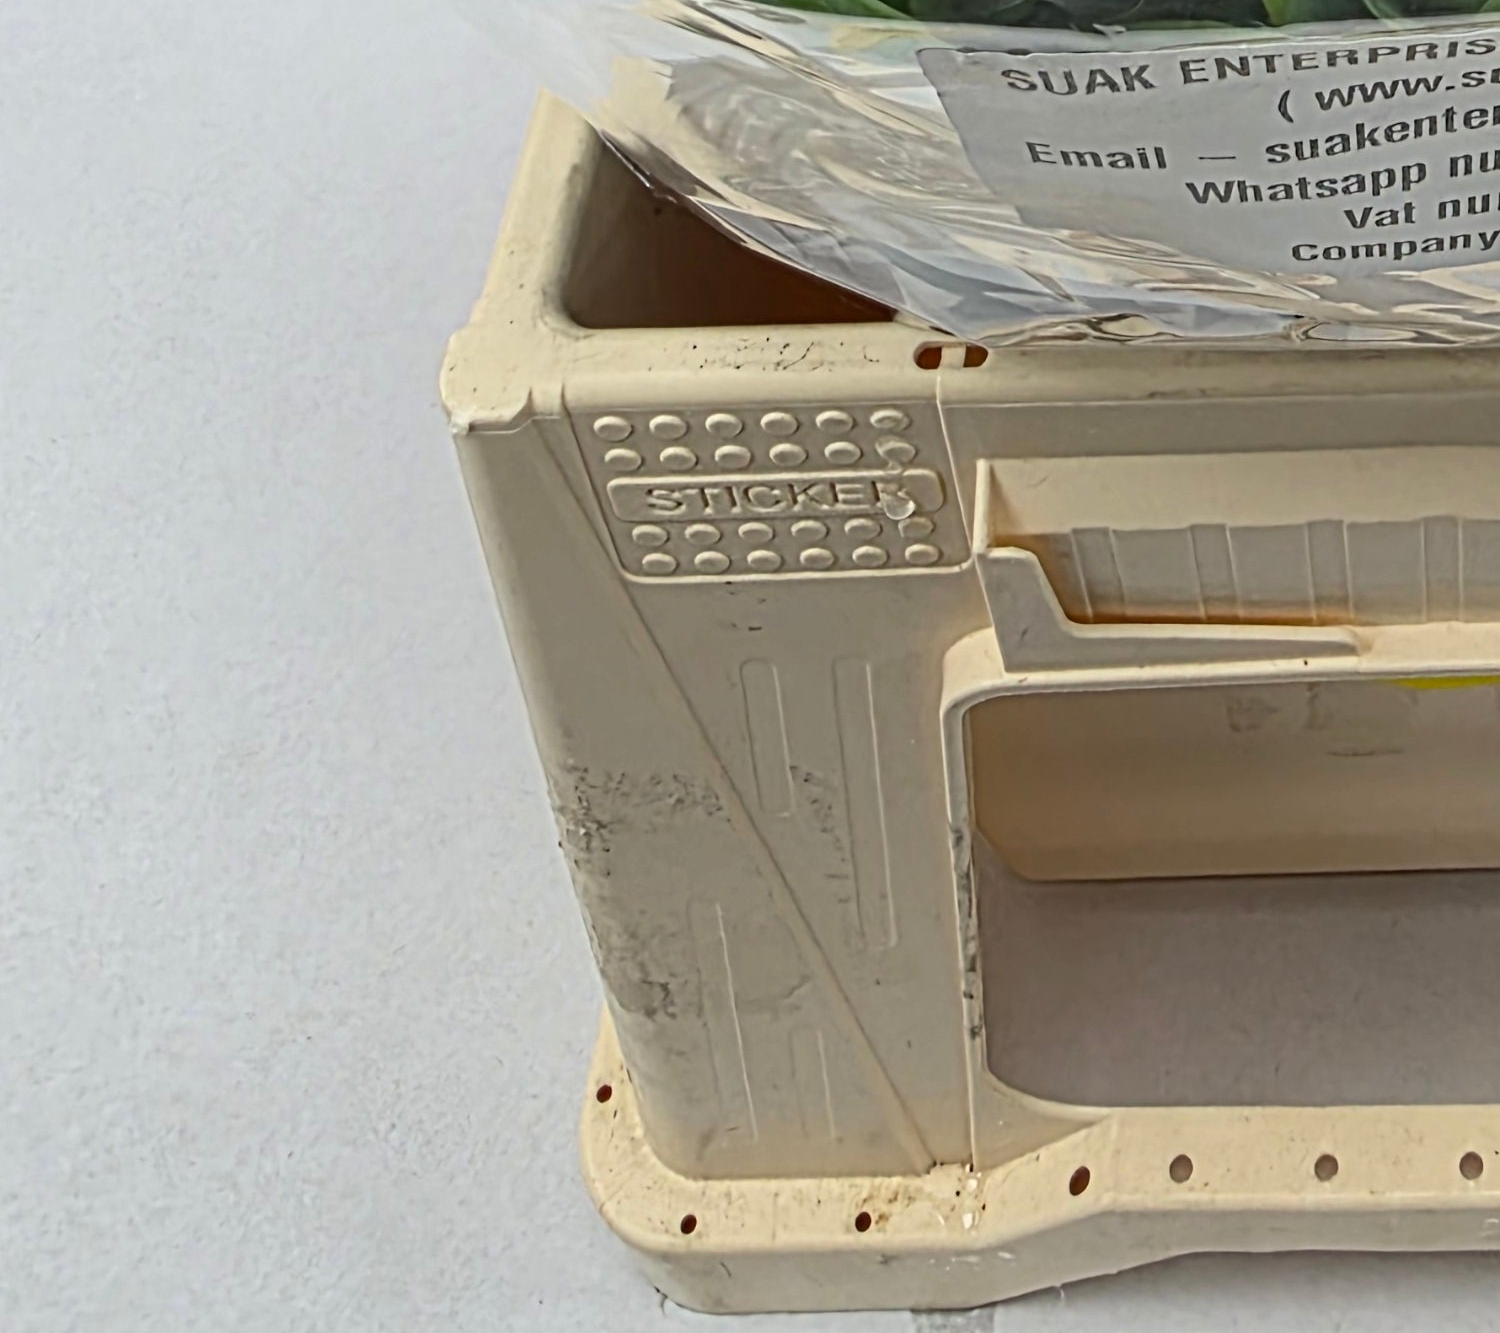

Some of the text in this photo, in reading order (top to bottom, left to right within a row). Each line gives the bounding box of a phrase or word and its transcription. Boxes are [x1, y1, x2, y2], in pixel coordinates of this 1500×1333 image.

[1000, 64, 1158, 96] SUAK
[1025, 141, 1168, 170] Email
[1185, 161, 1428, 205] Whatsapp
[1344, 201, 1416, 230] Vat
